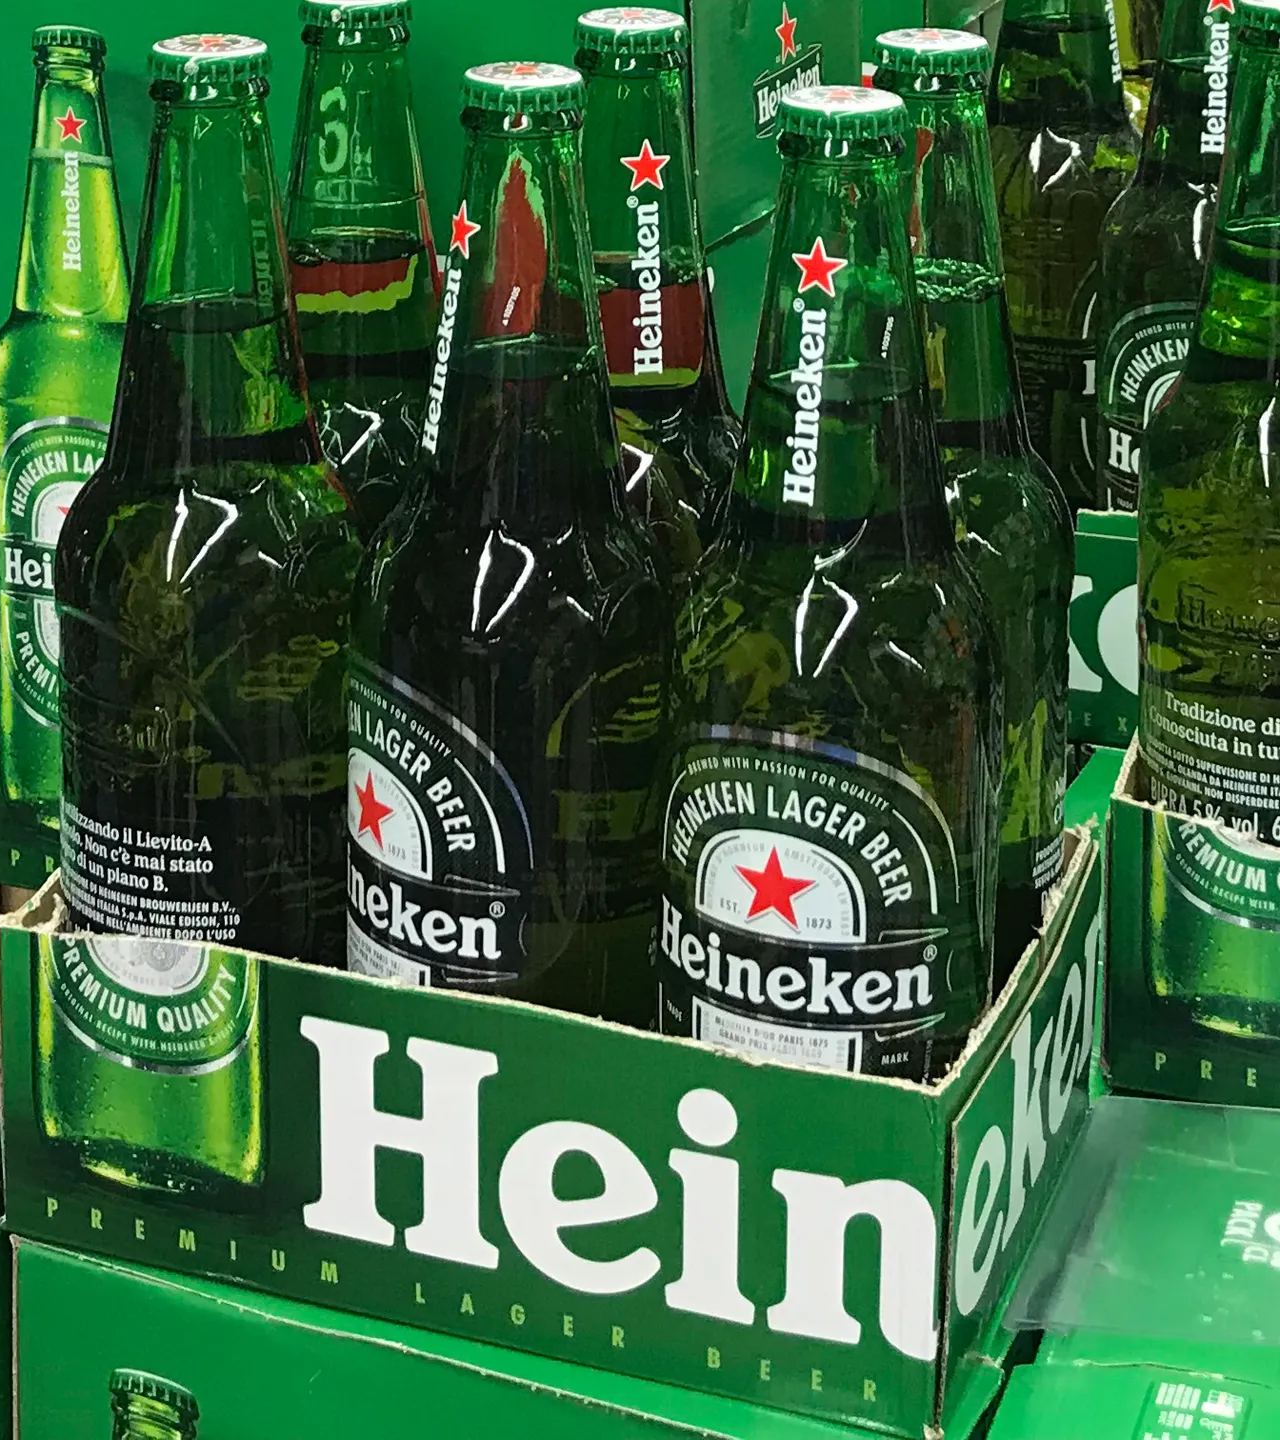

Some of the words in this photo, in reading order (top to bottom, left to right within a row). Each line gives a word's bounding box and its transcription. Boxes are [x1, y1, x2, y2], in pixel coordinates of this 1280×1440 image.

[1200, 20, 1230, 155] Heineken
[62, 151, 83, 273] Heineken
[633, 201, 663, 377] Heineken
[421, 267, 462, 456] Heineken
[1120, 337, 1190, 403] HEINEKEN
[782, 307, 827, 507] Heineken
[11, 450, 67, 518] HEINEKEN
[410, 718, 452, 758] QUALITY
[1149, 703, 1228, 752] Conosciuta
[1233, 736, 1253, 759] in
[1165, 691, 1256, 734] Tradizione
[365, 710, 432, 783] LAGER
[426, 775, 477, 853] BEER
[721, 755, 751, 770] WITH
[754, 758, 806, 780] PASSION
[811, 770, 836, 787] FOR
[840, 779, 890, 812] QUALITY
[1195, 757, 1257, 782] SUPERVISIONE
[1259, 771, 1271, 783] DI
[1204, 785, 1224, 801] NON
[1225, 790, 1280, 811] DISPERDERE
[1208, 774, 1221, 787] DA
[1222, 778, 1268, 796] HEINEKEN
[85, 836, 108, 859] Non
[134, 853, 166, 872] mai
[170, 857, 214, 874] stato
[122, 828, 133, 844] il
[136, 830, 212, 853] Lievito-A
[671, 780, 756, 867] HEINEKEN
[766, 785, 867, 847] LAGER
[860, 829, 913, 908] BEER
[88, 858, 105, 879] un
[107, 869, 149, 892] piano
[153, 875, 170, 893] B.
[98, 884, 138, 907] HEINEKEN
[140, 896, 210, 914] BROUWERIJEN
[149, 912, 176, 926] VIALE
[179, 915, 221, 929] EDISON,
[223, 913, 241, 927] 110
[174, 925, 204, 940] DOPO
[206, 928, 236, 940] L'USO
[805, 916, 833, 931] 1873
[661, 893, 933, 1016] Heineken
[61, 936, 148, 1030] PREMIUM
[156, 964, 237, 1034] QUALITY
[778, 1033, 805, 1047] PARIS
[881, 1051, 909, 1066] MARK
[300, 1015, 938, 1361] Hein
[46, 1196, 339, 1285] PREMIUM
[414, 1281, 625, 1349] LAGER
[706, 1346, 878, 1403] BEER
